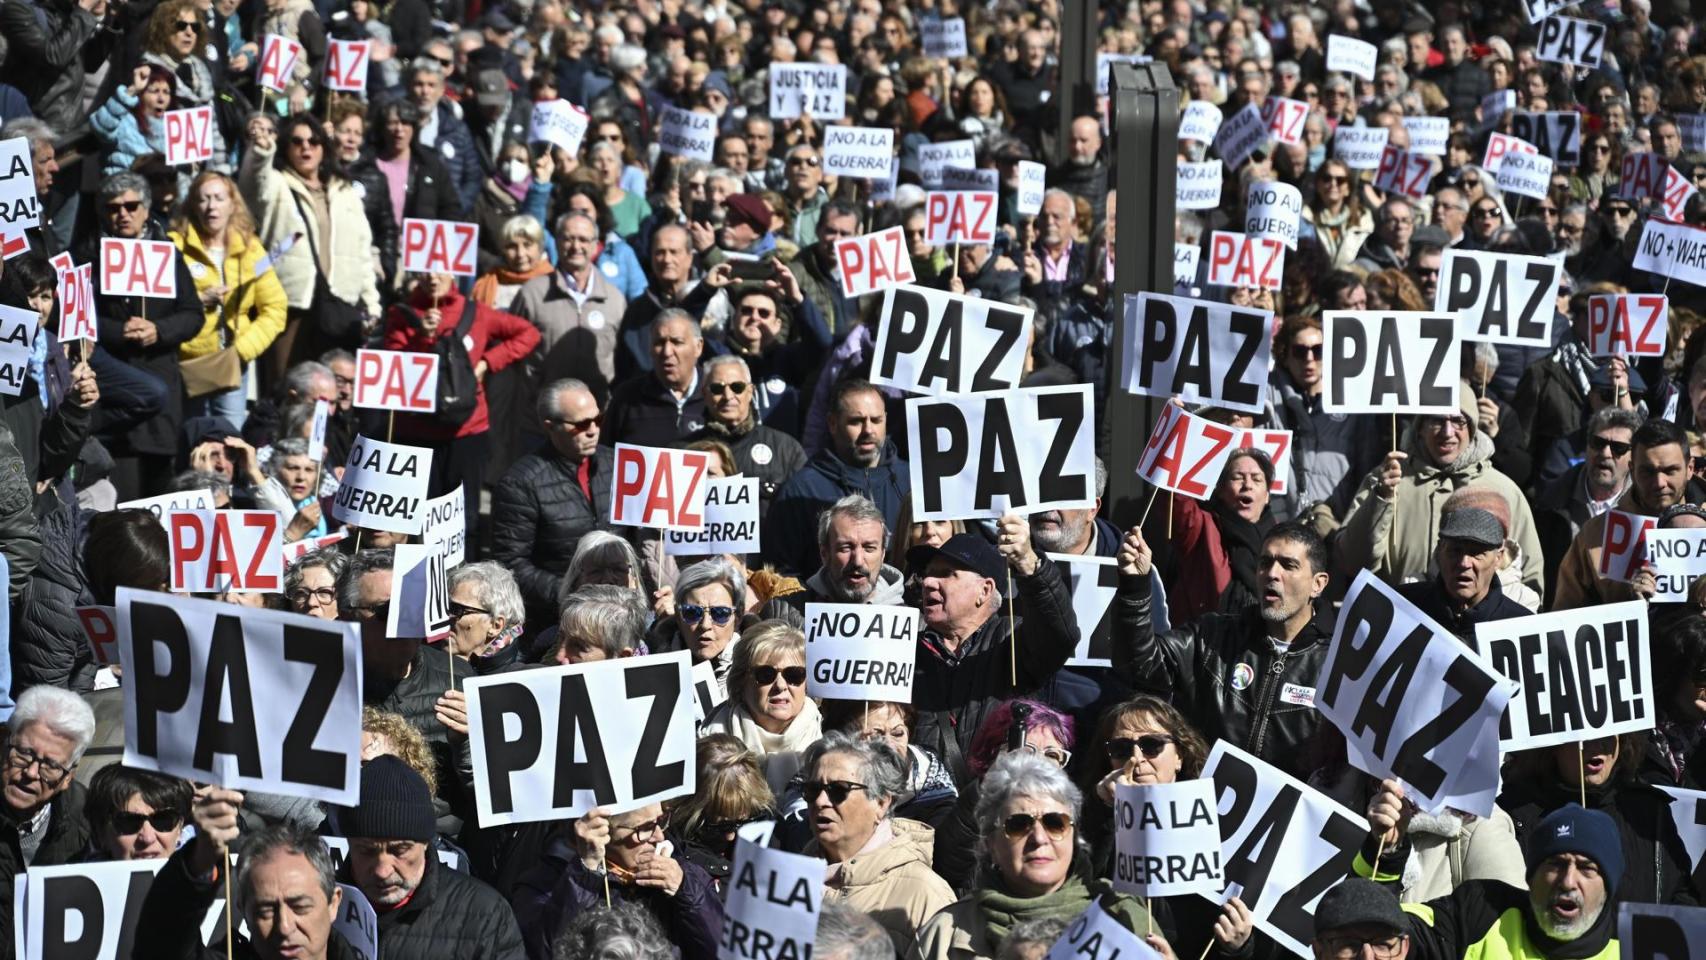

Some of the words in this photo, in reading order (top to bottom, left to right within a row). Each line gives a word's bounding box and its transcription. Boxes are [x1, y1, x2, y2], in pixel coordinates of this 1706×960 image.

[1540, 18, 1604, 64] PAZ
[777, 70, 838, 89] JUSTICIA
[777, 95, 785, 111] Y
[167, 109, 211, 161] PAZ
[695, 118, 709, 130] LA
[828, 133, 854, 146] ¡NO
[857, 134, 866, 144] A
[870, 134, 886, 145] LA
[828, 155, 888, 169] GUERRA!
[1377, 147, 1431, 197] PAZ
[928, 194, 994, 240] PAZ
[1249, 191, 1277, 208] ¡NO
[1281, 194, 1291, 208] A
[105, 241, 172, 293] PAZ
[405, 222, 475, 272] PAZ
[838, 231, 911, 293] PAZ
[1211, 235, 1281, 286] PAZ
[1643, 230, 1664, 257] NO
[1447, 256, 1555, 339] PAZ
[880, 289, 1024, 393] PAZ
[1590, 298, 1664, 354] PAZ
[1138, 299, 1263, 405] PAZ
[1331, 317, 1453, 406] PAZ
[358, 353, 434, 408] PAZ
[363, 449, 381, 472] A
[386, 453, 417, 477] LA
[917, 392, 1086, 512] PAZ
[1139, 404, 1234, 496] PAZ
[614, 448, 706, 526] PAZ
[725, 485, 750, 504] LA
[426, 502, 452, 532] ¡NO
[171, 513, 278, 589] PAZ
[808, 612, 860, 642] ¡NO
[864, 614, 884, 638] A
[890, 615, 911, 640] LA
[129, 600, 348, 790] PAZ
[814, 659, 912, 686] GUERRA!
[1322, 583, 1496, 800] PAZ
[1490, 619, 1645, 740] PEACE!
[478, 662, 686, 814] PAZ
[1139, 802, 1162, 830] A
[1169, 798, 1213, 829] LA
[1117, 851, 1220, 884] GUERRA!
[1208, 752, 1366, 946] PAZ
[736, 861, 758, 897] A
[768, 870, 814, 913] LA
[345, 901, 363, 929] A
